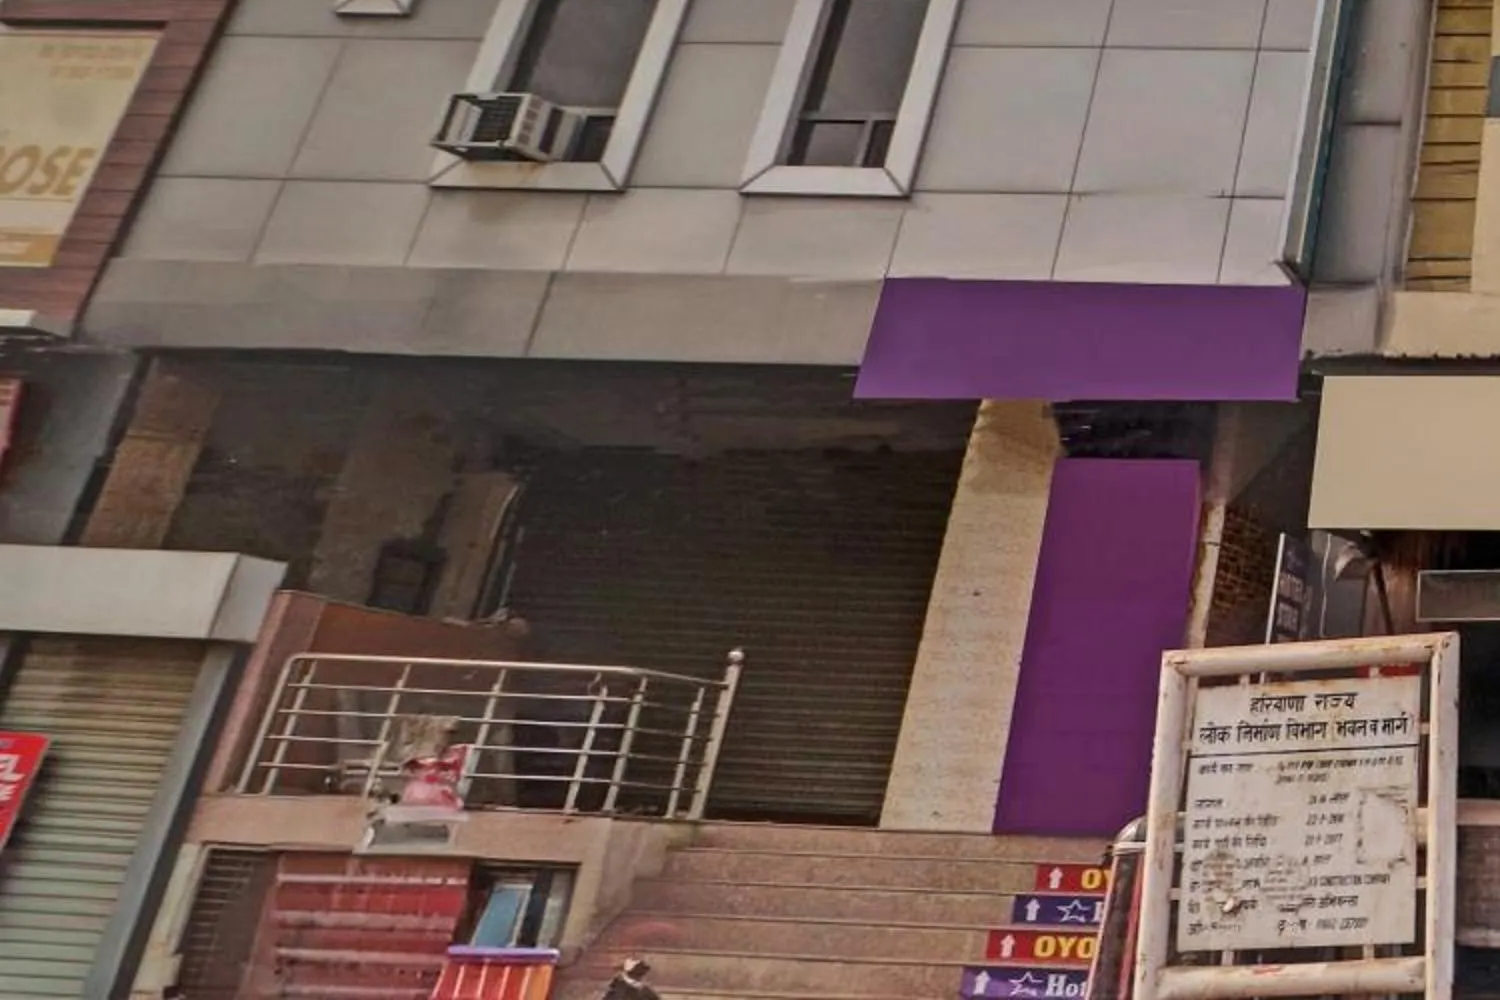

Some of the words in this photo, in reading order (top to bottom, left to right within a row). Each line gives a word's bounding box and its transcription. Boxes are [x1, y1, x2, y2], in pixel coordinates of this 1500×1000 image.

[0, 145, 98, 197] OSE
[1314, 692, 1358, 711] राज्य
[1034, 935, 1098, 958] OYO
